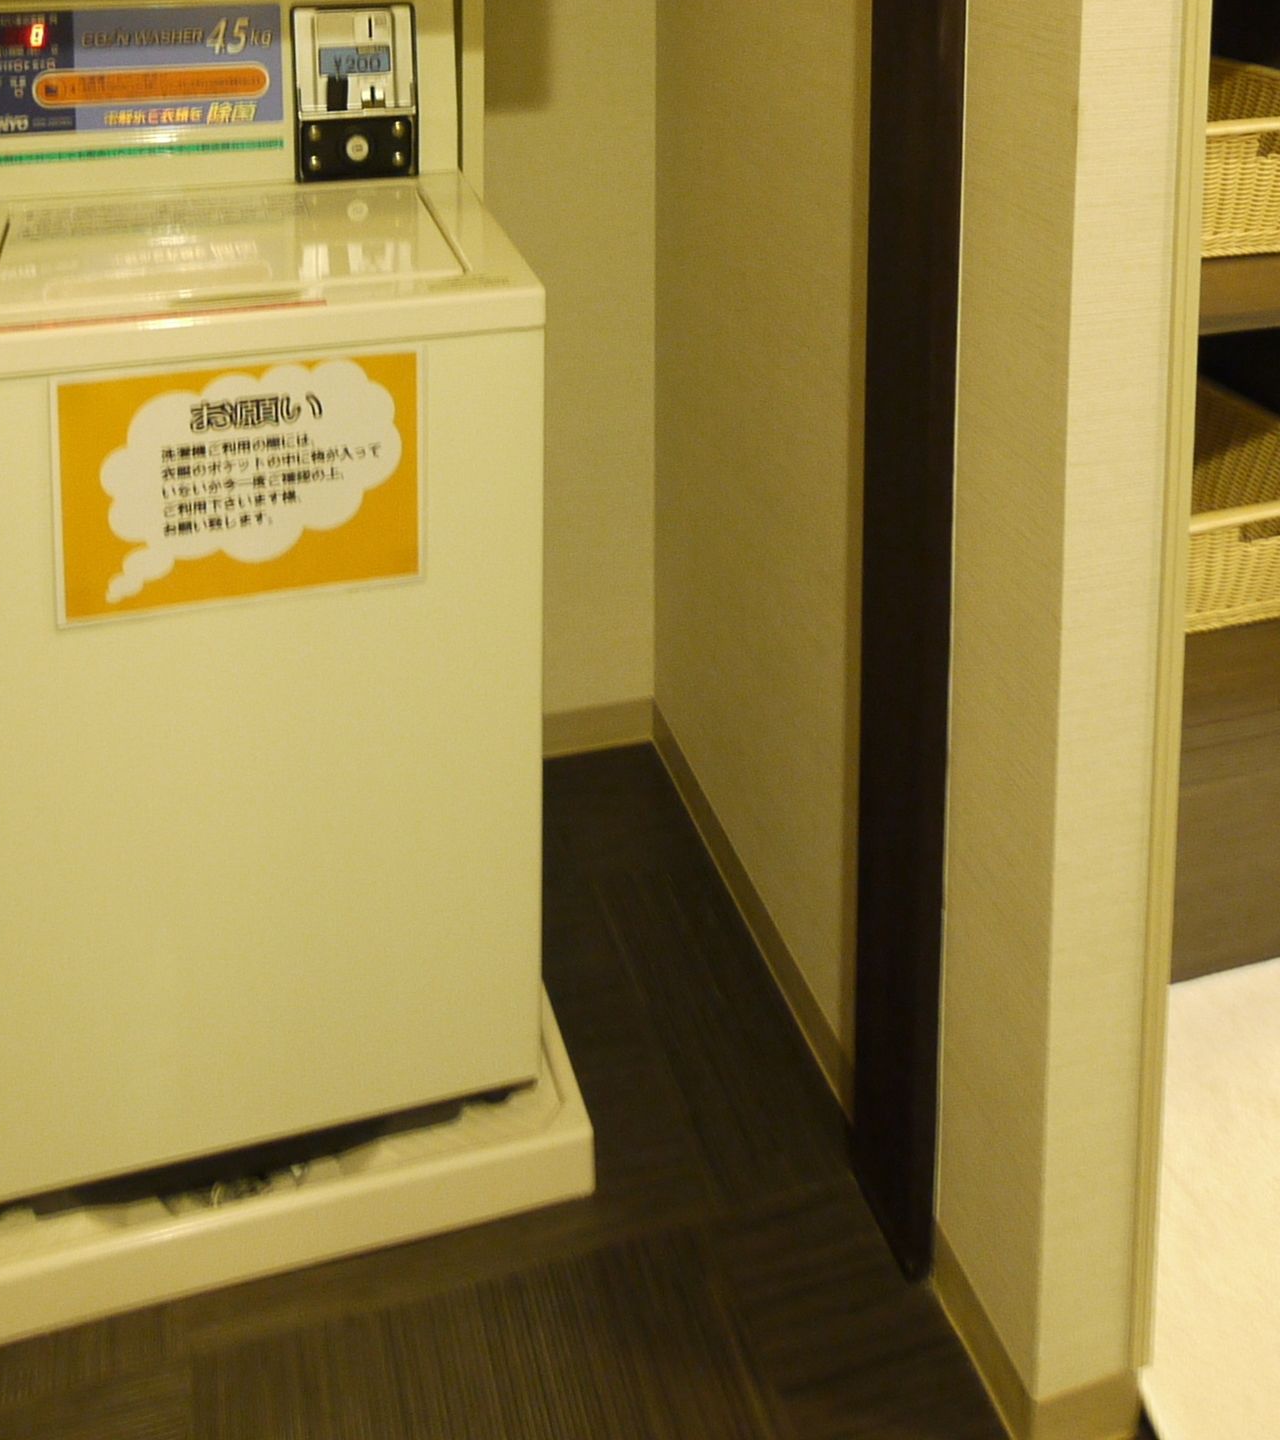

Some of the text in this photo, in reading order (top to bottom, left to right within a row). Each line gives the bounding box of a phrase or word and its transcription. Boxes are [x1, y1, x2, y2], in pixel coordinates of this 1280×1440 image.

[133, 27, 205, 47] WASHER
[189, 391, 324, 433] お願い
